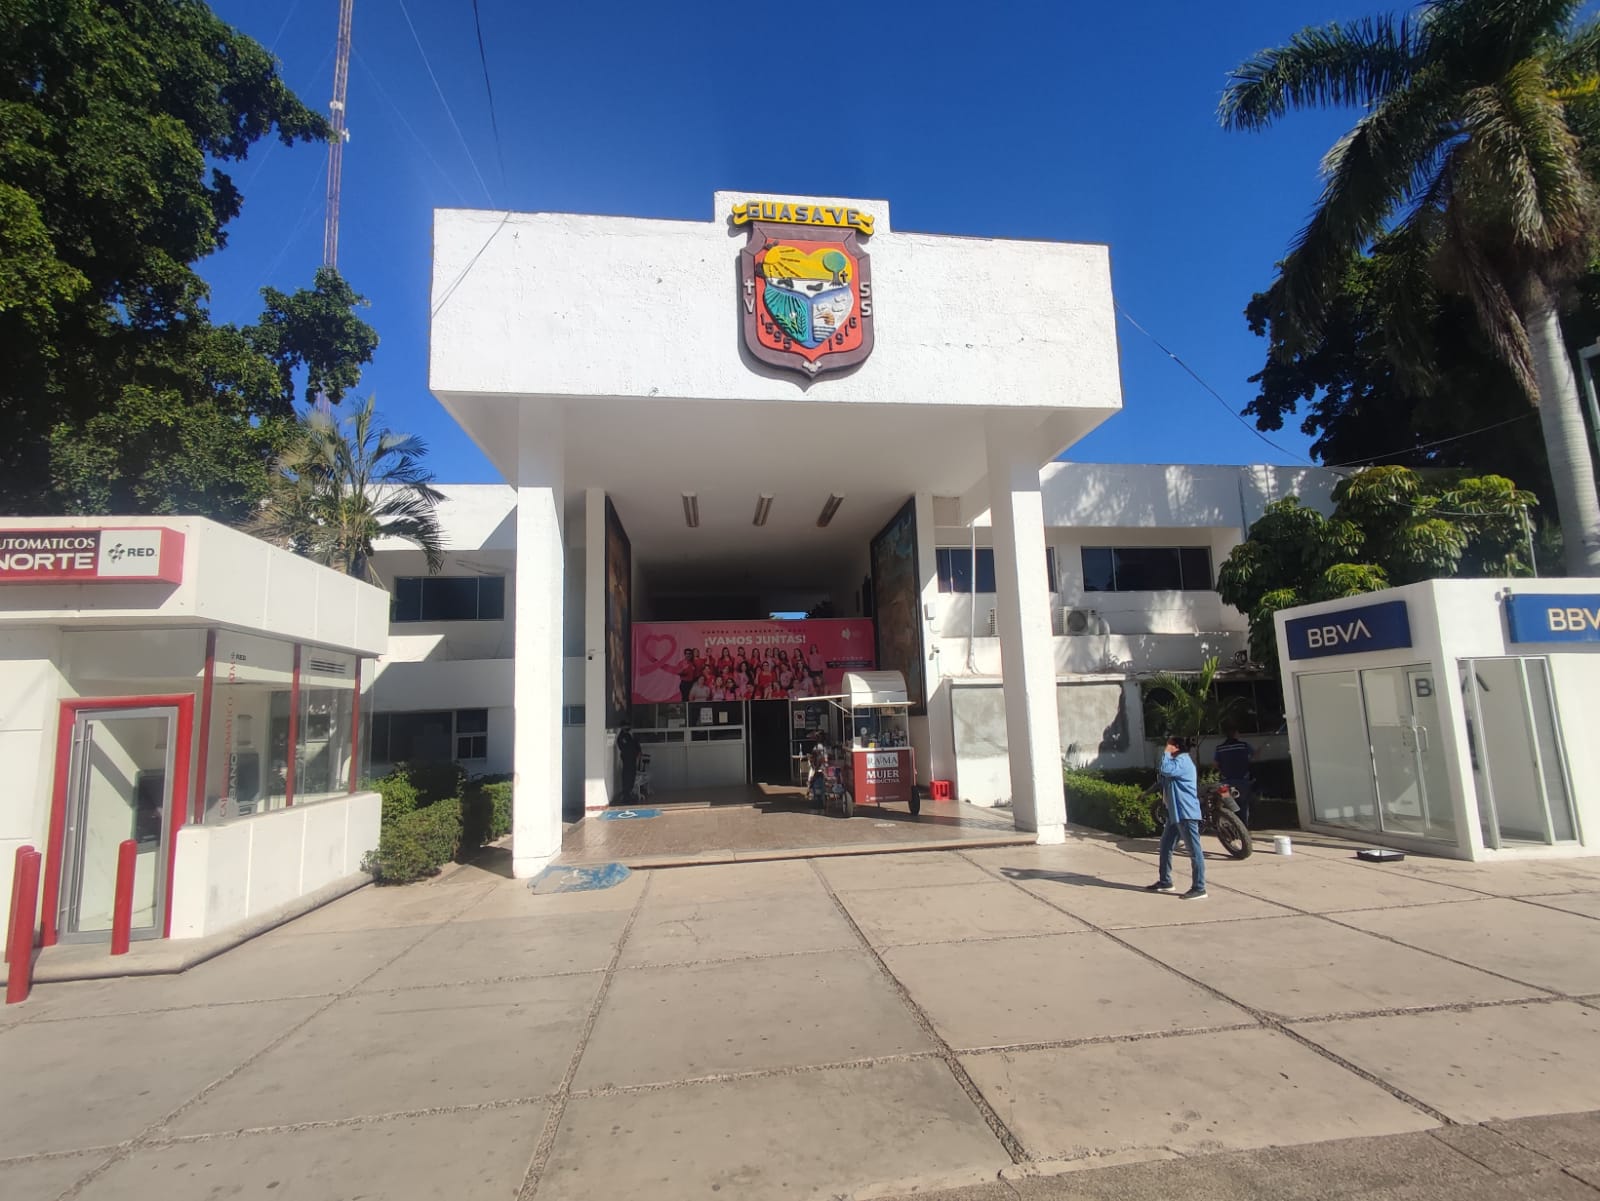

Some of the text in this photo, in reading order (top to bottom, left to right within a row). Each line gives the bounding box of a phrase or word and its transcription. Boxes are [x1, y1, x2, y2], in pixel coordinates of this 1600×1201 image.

[747, 201, 861, 225] GUASAVE
[1547, 607, 1600, 631] BBV
[1307, 618, 1372, 648] BBVA
[866, 769, 900, 780] MUJER
